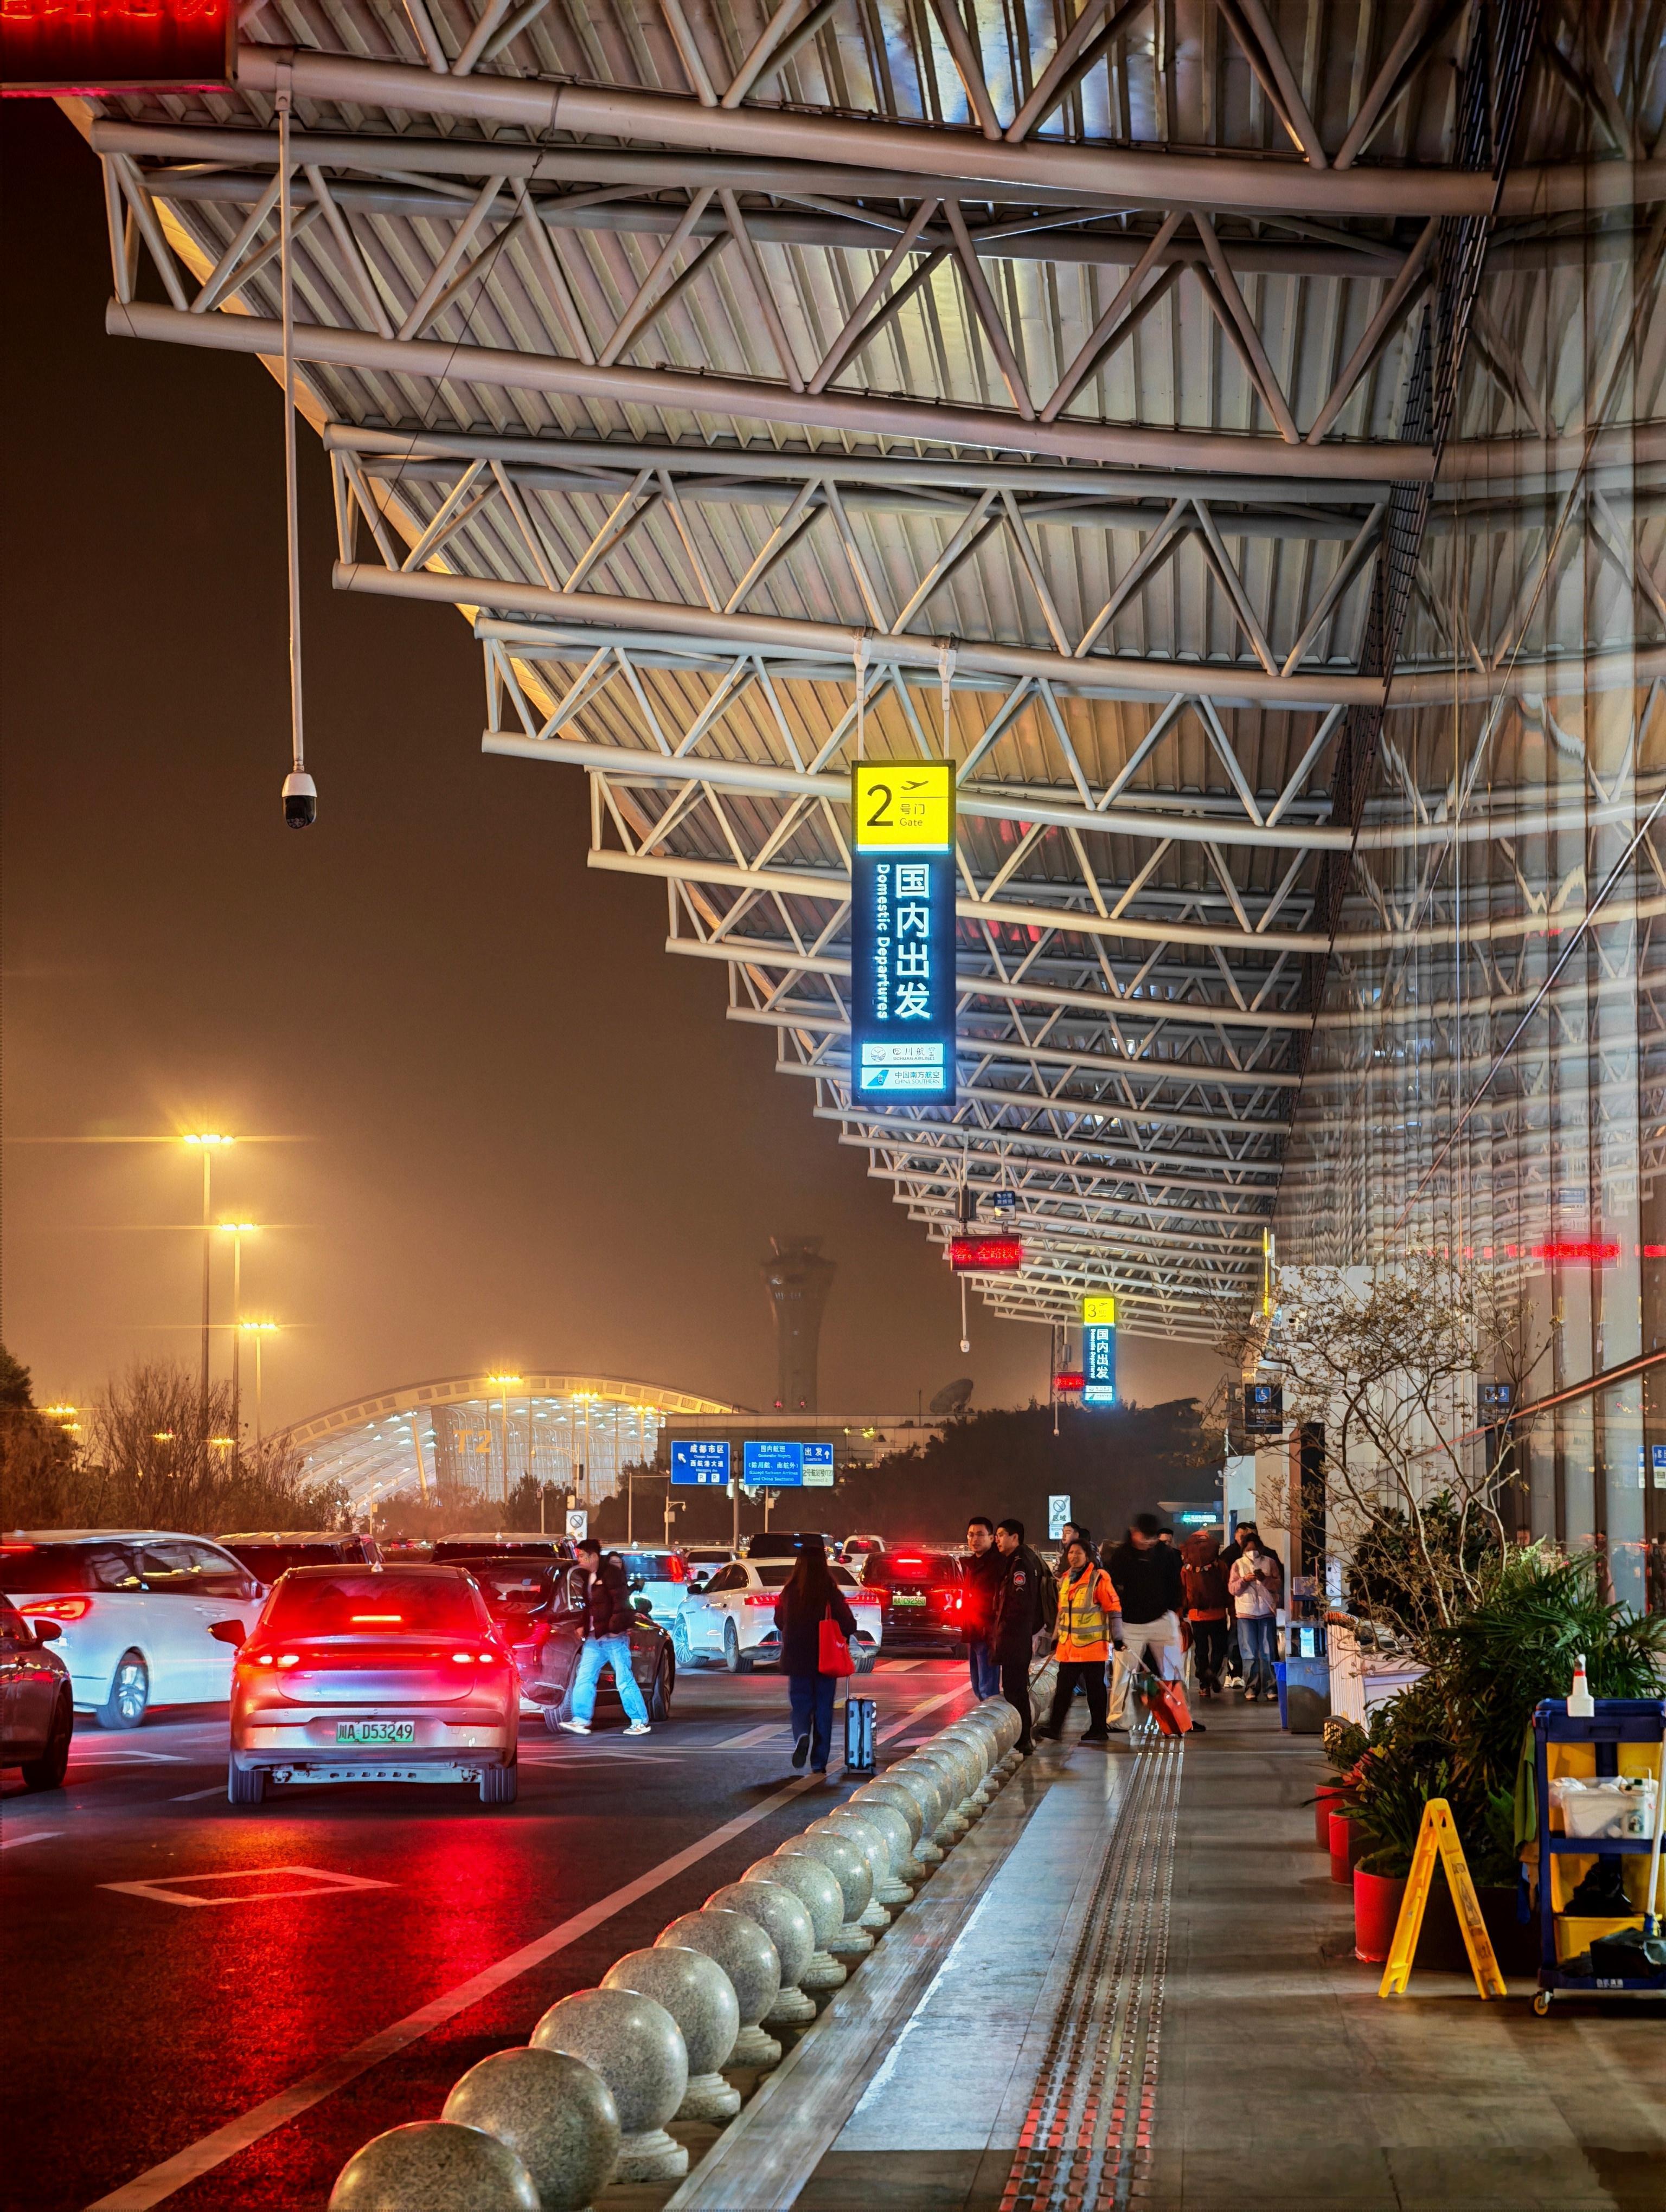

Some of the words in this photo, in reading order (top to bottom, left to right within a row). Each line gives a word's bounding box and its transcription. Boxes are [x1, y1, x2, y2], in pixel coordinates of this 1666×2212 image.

[867, 784, 894, 826] 2
[900, 803, 925, 815] 号门
[900, 818, 923, 827] Gate
[876, 864, 890, 930] Domestic
[895, 864, 931, 1019] 国内出发
[876, 937, 890, 1019] Departures
[893, 1047, 935, 1056] 四川航空
[1088, 1304, 1097, 1317] 3
[1096, 1328, 1109, 1379] 国内出发
[453, 1430, 491, 1454] T2
[690, 1444, 725, 1454] 成都市区
[804, 1447, 823, 1456] 出发
[690, 1459, 724, 1468] 西航港大道
